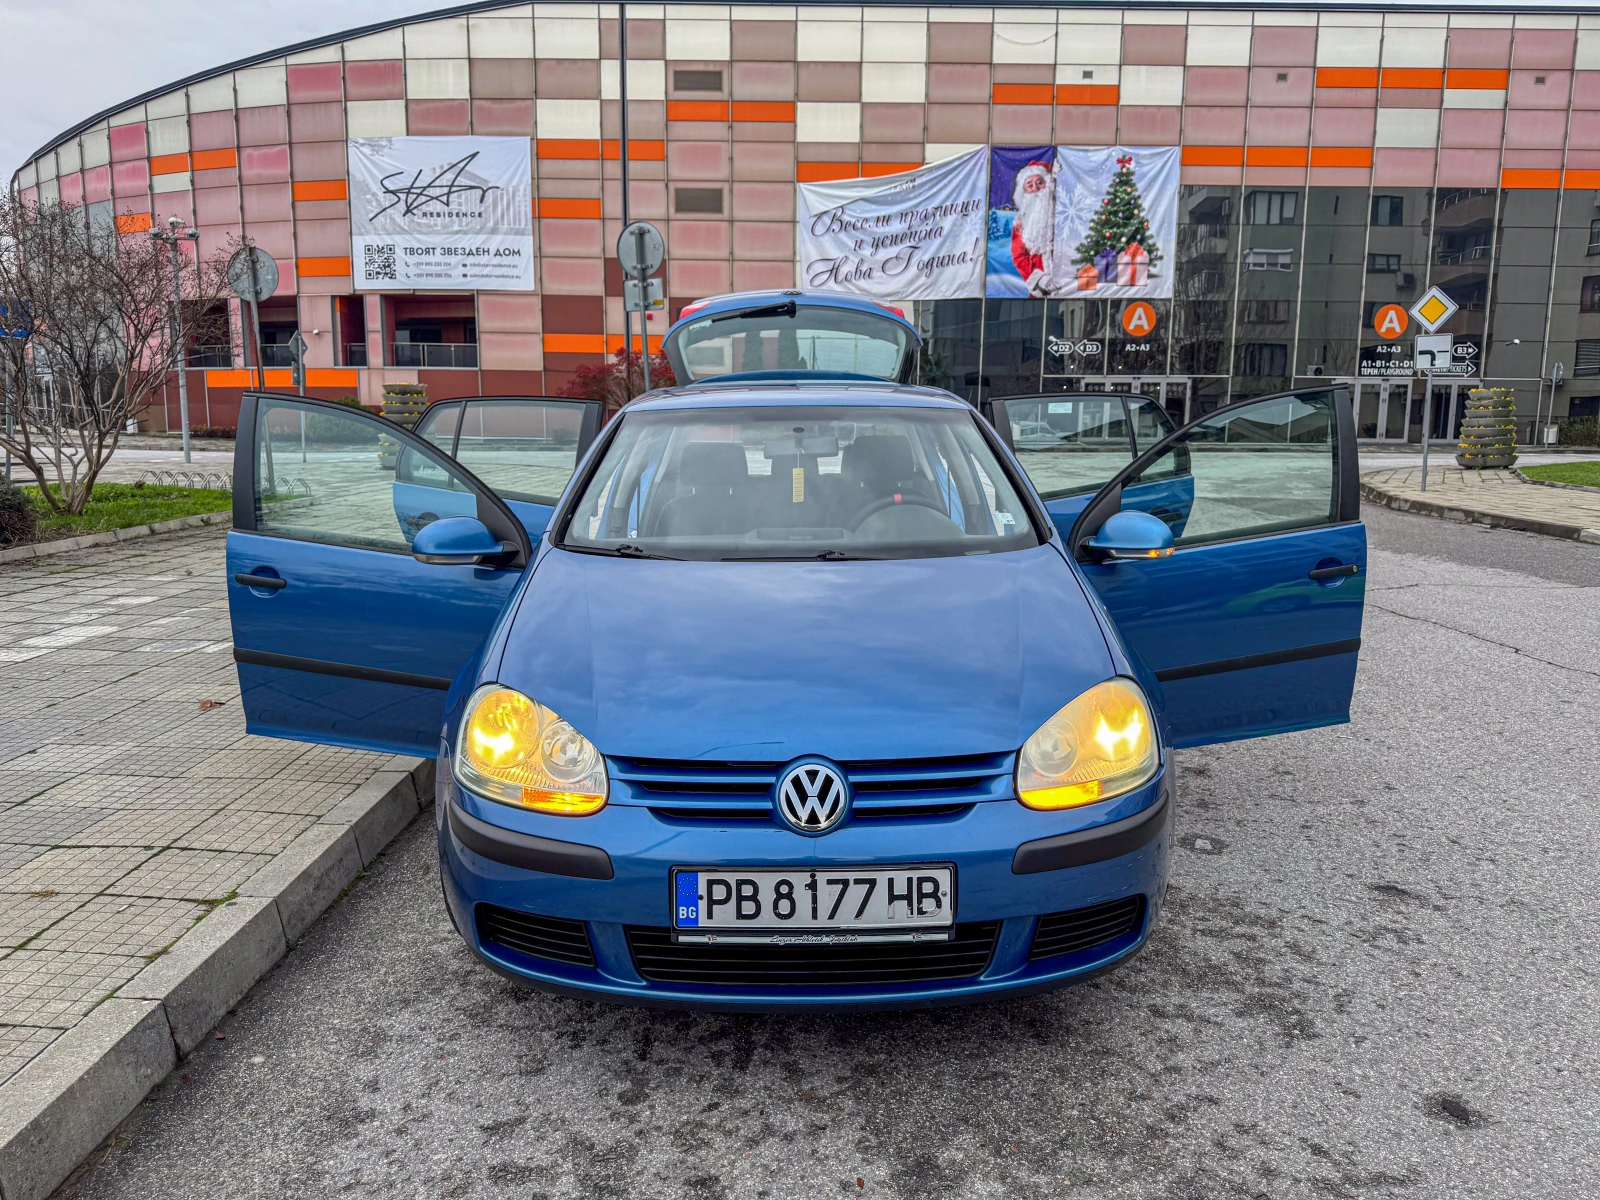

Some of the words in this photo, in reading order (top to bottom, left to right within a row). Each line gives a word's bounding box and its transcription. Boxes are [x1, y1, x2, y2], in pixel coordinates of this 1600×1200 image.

[403, 247, 437, 256] ТВОЯТ
[440, 247, 490, 257] ЗВЕЗДЕН
[494, 248, 521, 257] ДОМ
[853, 239, 865, 252] и
[870, 226, 945, 257] успешна
[806, 255, 875, 287] Нова
[882, 237, 980, 278] Година!
[1128, 307, 1149, 330] A
[1380, 310, 1401, 333] A
[706, 879, 761, 920] PB
[772, 877, 877, 920] 8177
[887, 876, 943, 919] HB
[679, 907, 697, 919] BG
